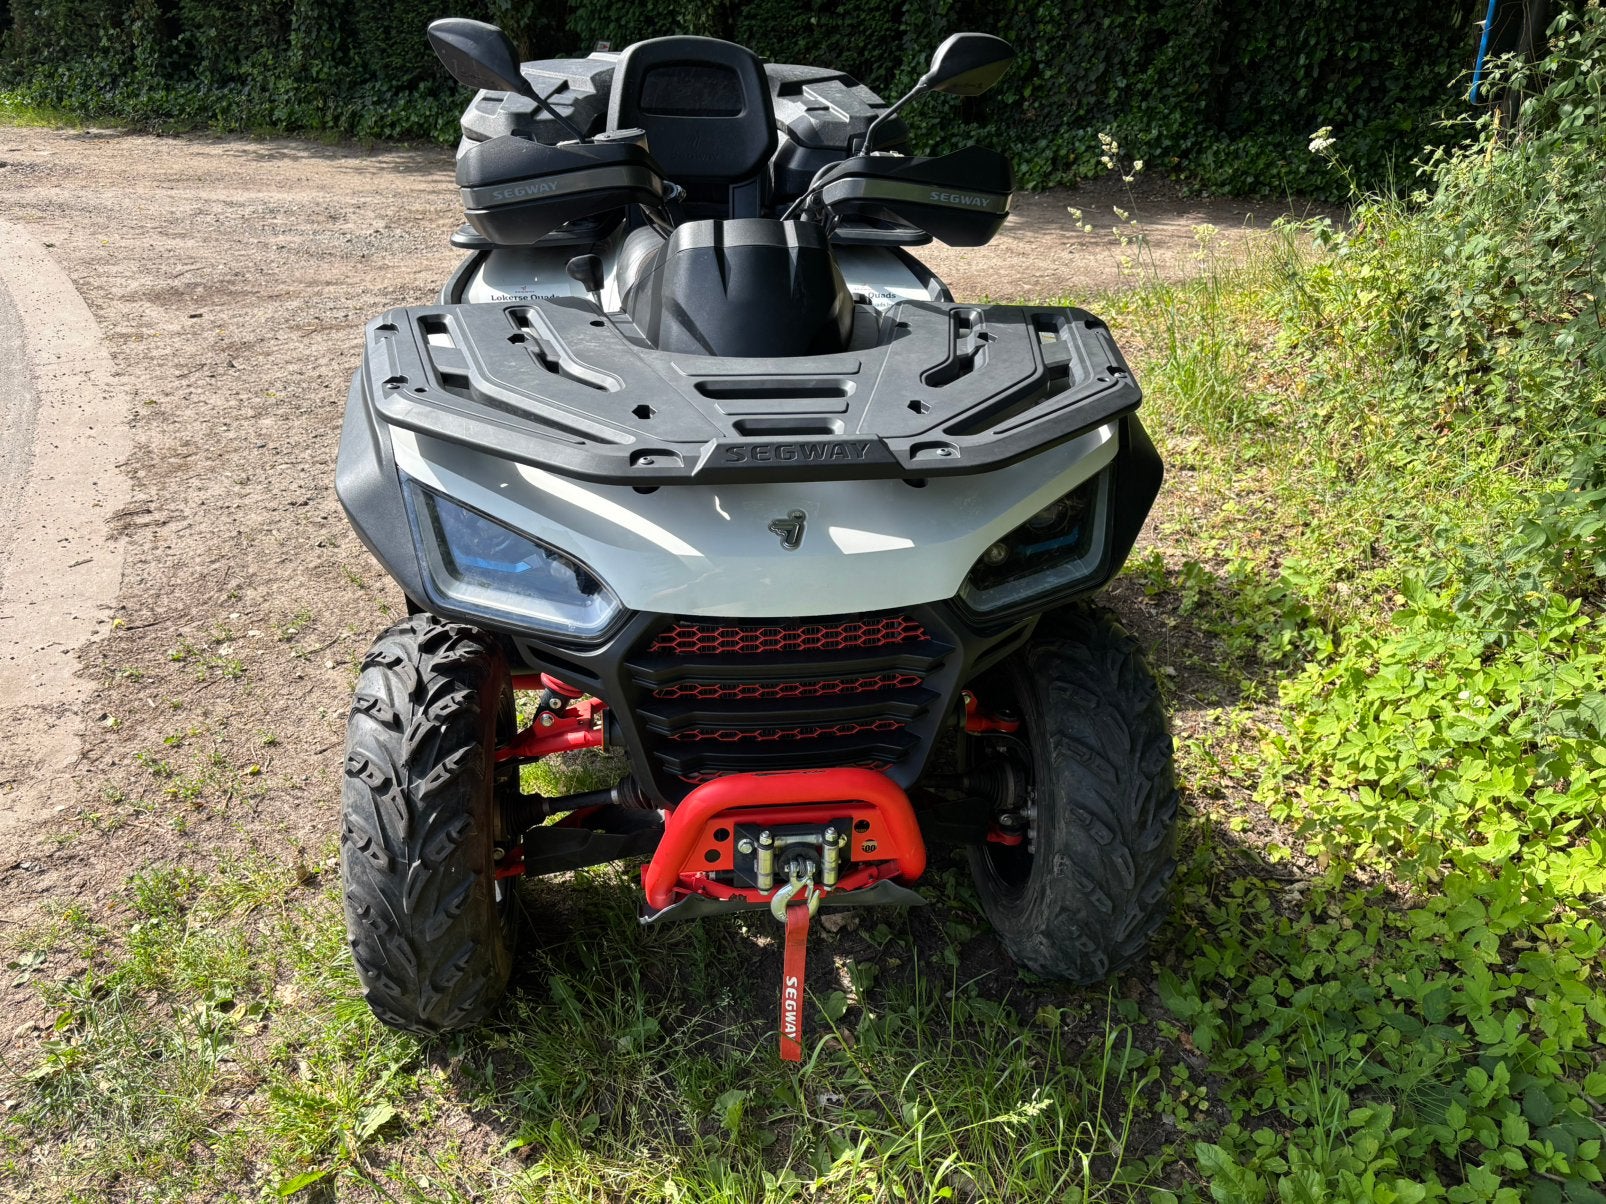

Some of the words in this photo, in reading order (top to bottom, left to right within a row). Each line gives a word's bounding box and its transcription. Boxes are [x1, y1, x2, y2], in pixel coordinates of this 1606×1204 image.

[492, 181, 558, 200] SEGWAY
[930, 191, 990, 207] SEGWAY
[530, 293, 560, 301] Quad
[725, 442, 871, 463] SEGWAY
[785, 975, 798, 1041] SEGWAY
